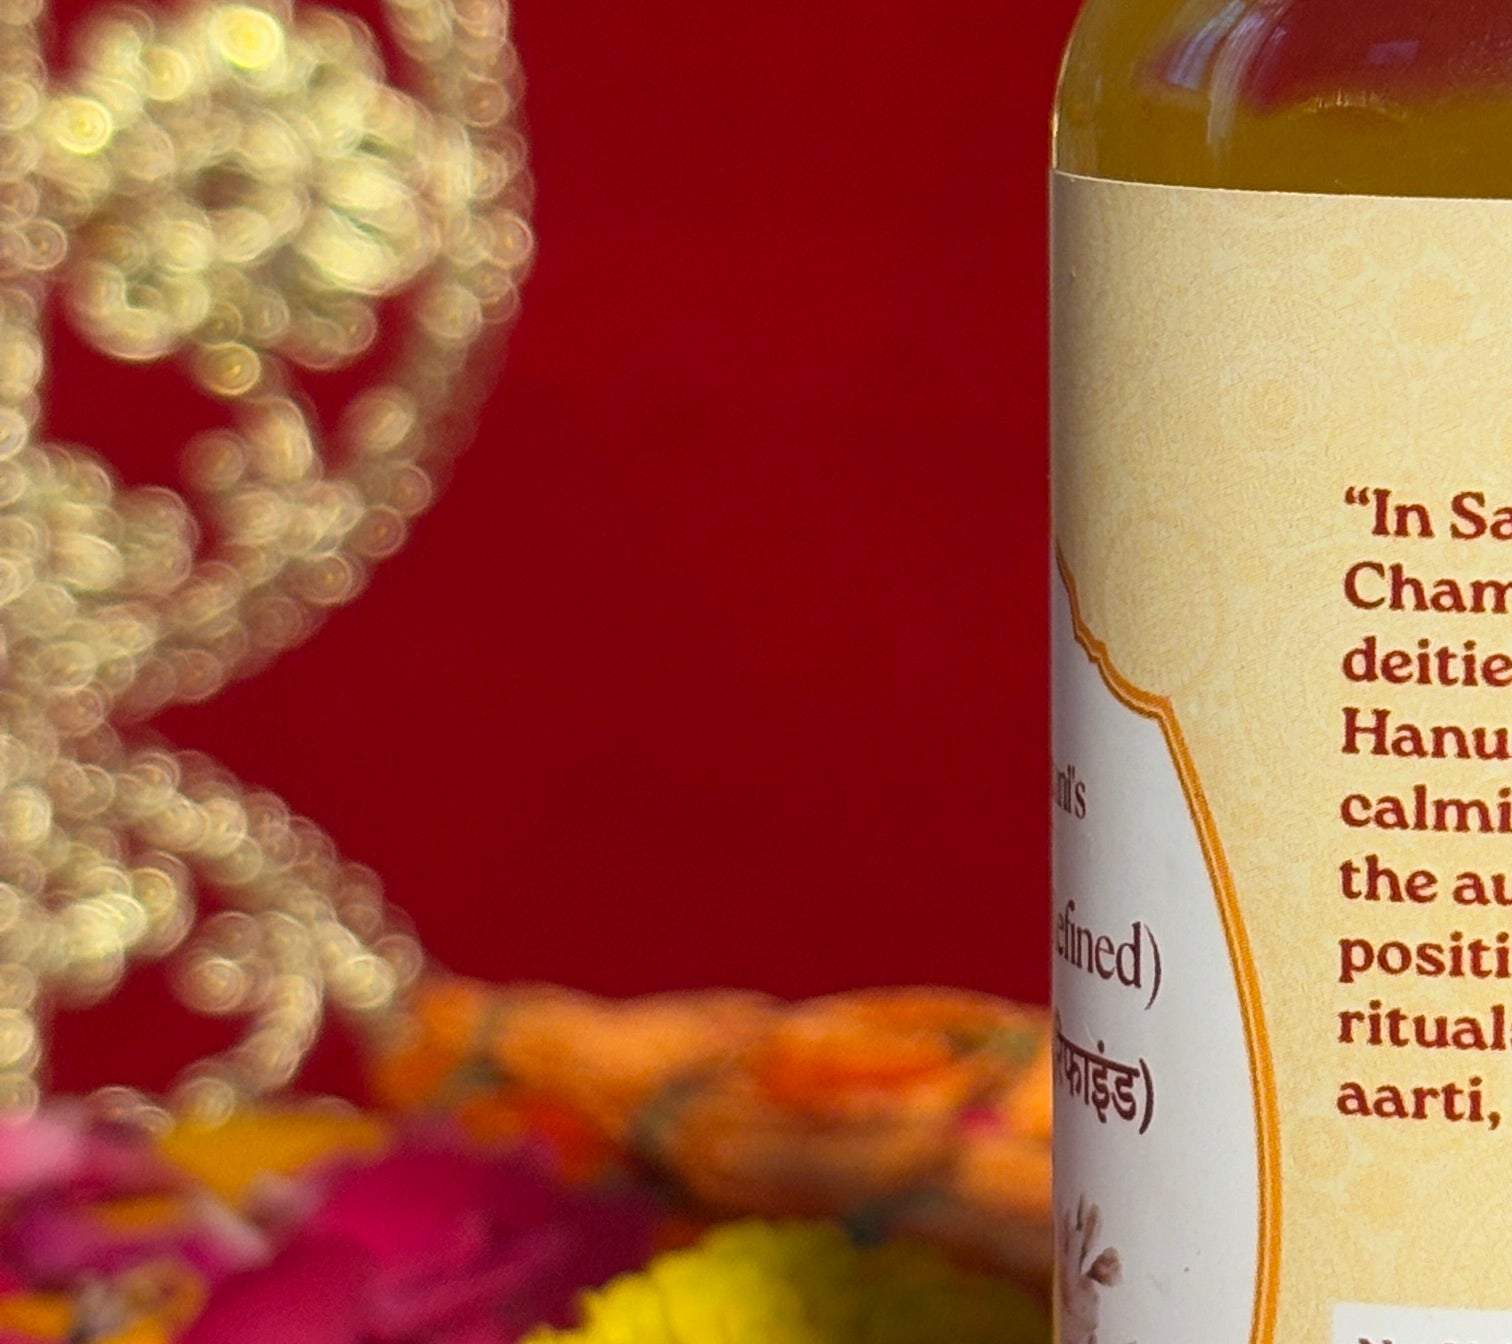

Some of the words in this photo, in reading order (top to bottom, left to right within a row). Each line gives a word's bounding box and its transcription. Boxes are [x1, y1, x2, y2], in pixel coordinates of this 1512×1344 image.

[1339, 855, 1438, 903] the
[1056, 899, 1161, 1010] efined)
[1336, 1076, 1500, 1130] aarti,
